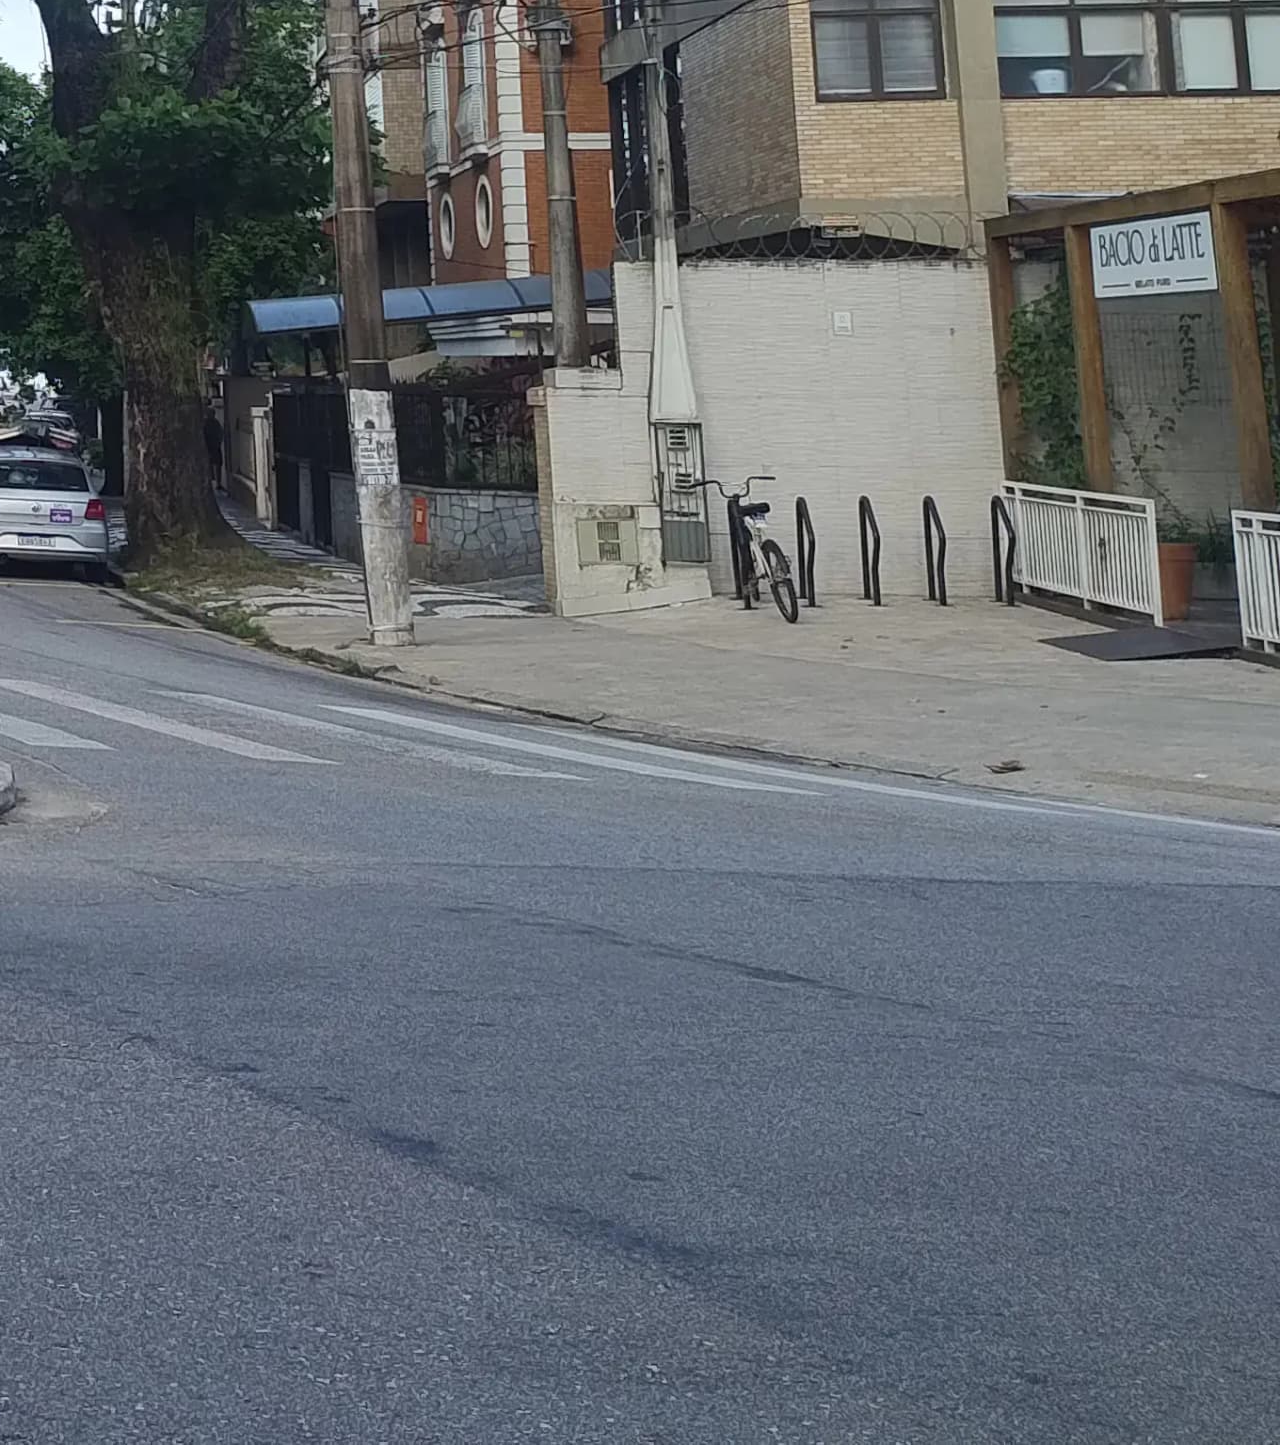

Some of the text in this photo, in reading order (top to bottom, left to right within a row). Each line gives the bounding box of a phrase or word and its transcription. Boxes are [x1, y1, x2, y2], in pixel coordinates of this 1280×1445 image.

[1098, 221, 1205, 267] BACIO di LATTE
